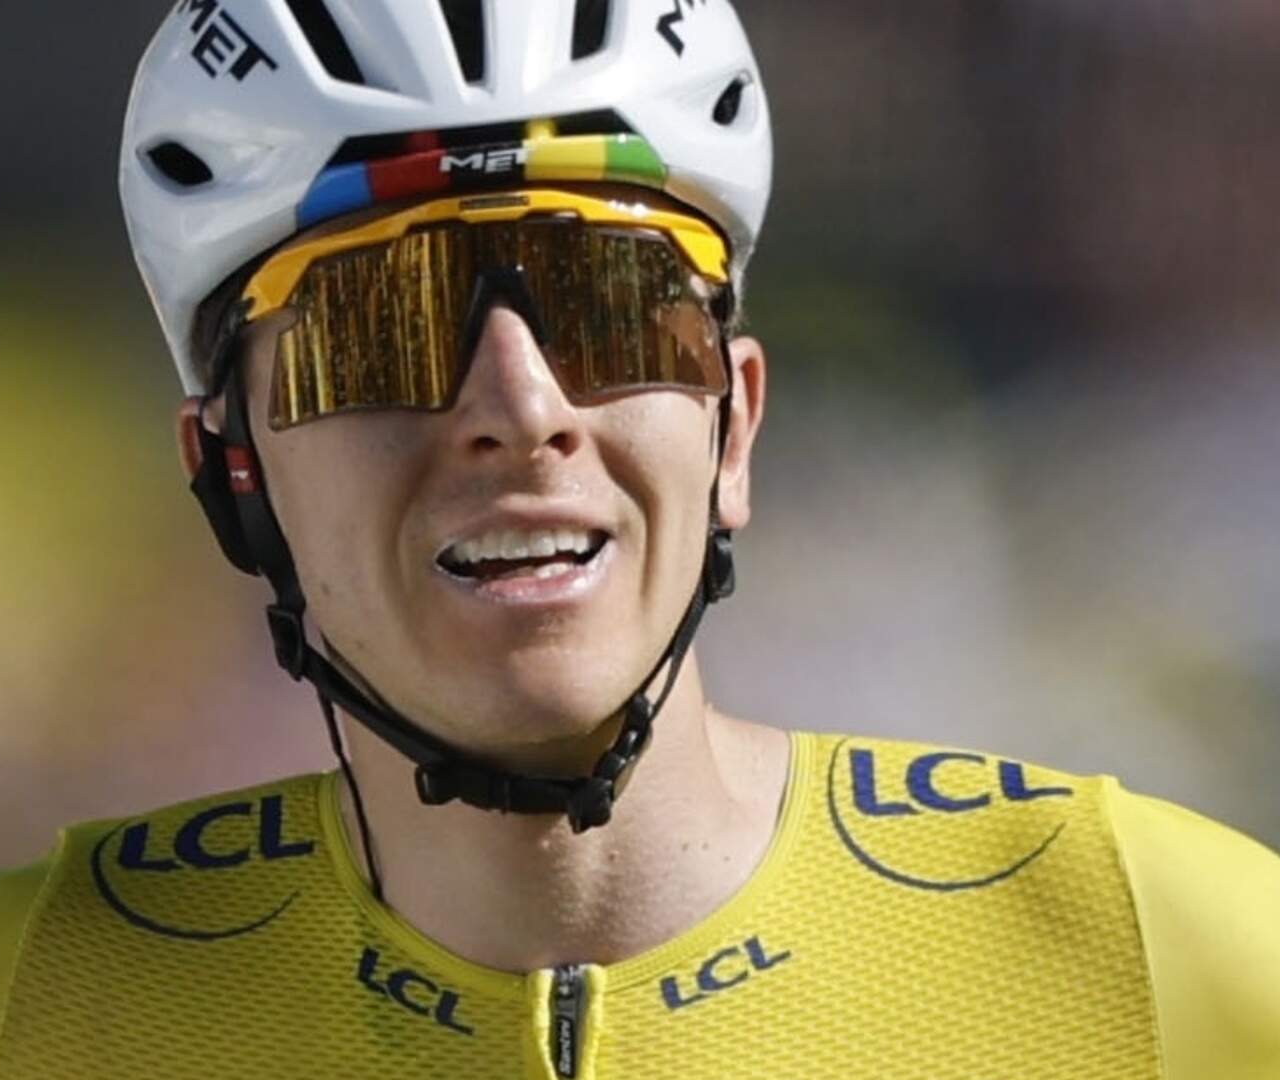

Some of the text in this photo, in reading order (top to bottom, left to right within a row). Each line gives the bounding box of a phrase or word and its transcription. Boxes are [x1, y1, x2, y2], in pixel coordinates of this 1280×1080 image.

[440, 148, 528, 172] MET
[849, 748, 1073, 816] LCL
[120, 795, 314, 871] LCL
[357, 946, 475, 1036] LCL
[659, 936, 791, 1011] LCL
